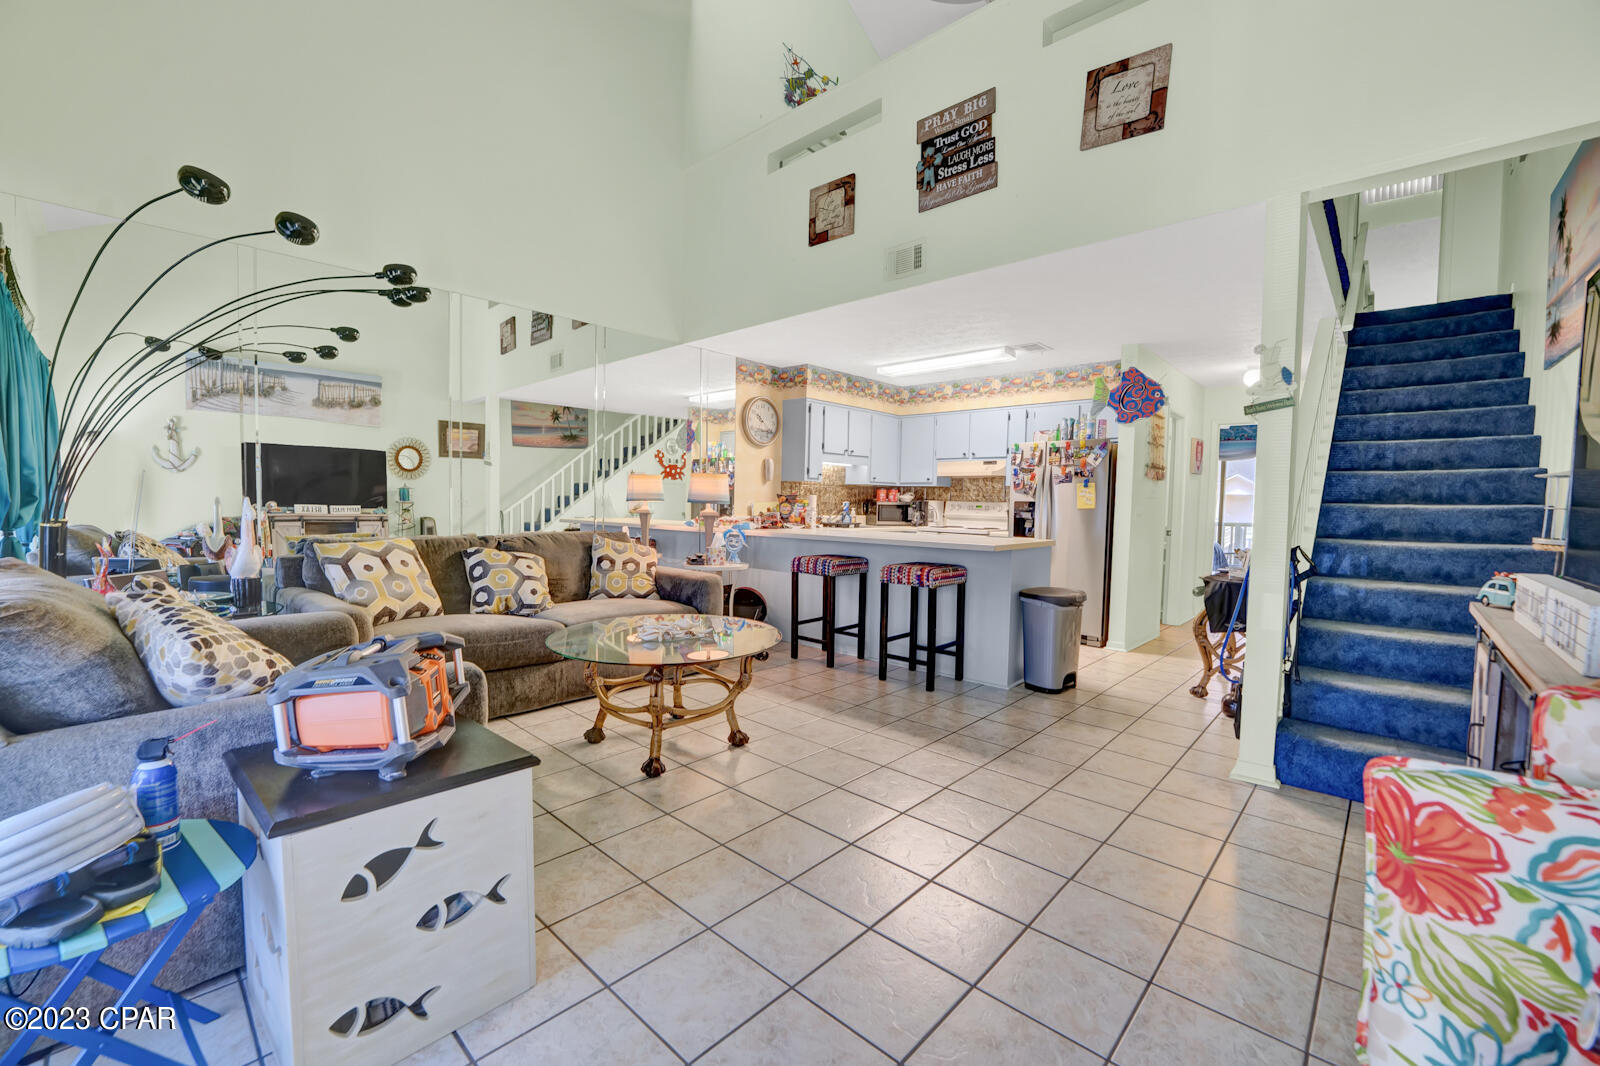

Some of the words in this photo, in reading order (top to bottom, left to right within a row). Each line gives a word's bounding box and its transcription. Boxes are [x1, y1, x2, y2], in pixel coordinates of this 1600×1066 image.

[1112, 80, 1139, 93] Love
[924, 107, 958, 131] PRAY
[964, 95, 988, 115] BIG
[954, 112, 975, 126] Small
[934, 131, 960, 148] Trust
[961, 119, 988, 138] GOD
[948, 149, 971, 165] LAUGH
[972, 140, 995, 156] MORE
[938, 162, 968, 179] Stress
[969, 152, 994, 169] Less
[936, 179, 956, 192] HAVE
[958, 169, 983, 185] FAITH
